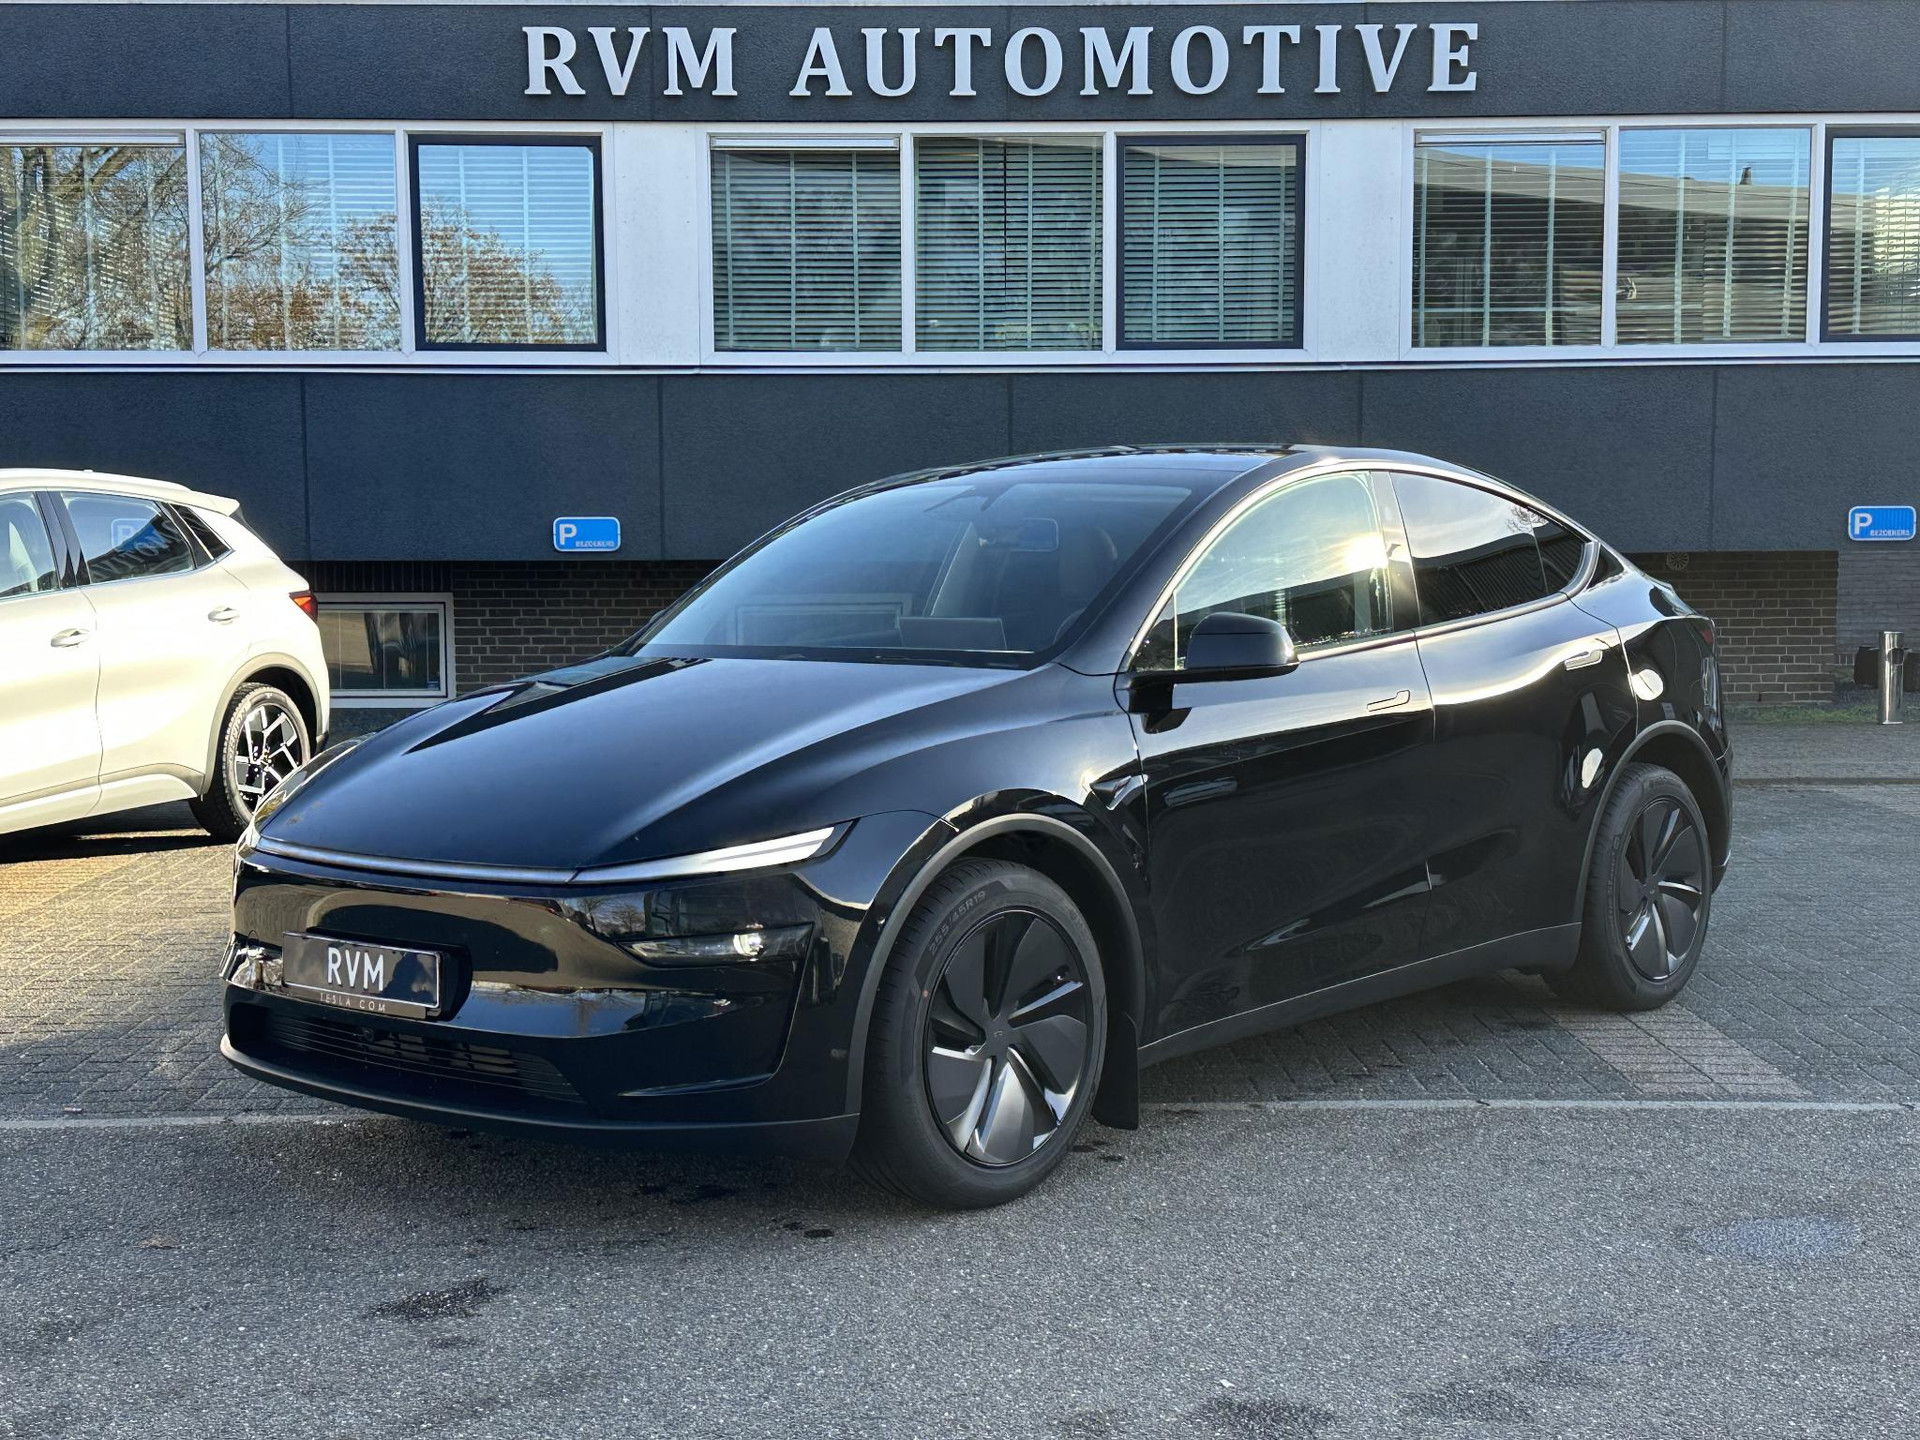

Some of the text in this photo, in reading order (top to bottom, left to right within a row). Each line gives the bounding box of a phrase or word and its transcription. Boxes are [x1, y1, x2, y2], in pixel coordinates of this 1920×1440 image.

[522, 23, 1479, 98] RVM AUTOMOTIVE
[559, 523, 577, 545] P
[1854, 512, 1872, 535] P
[327, 946, 384, 992] RVM
